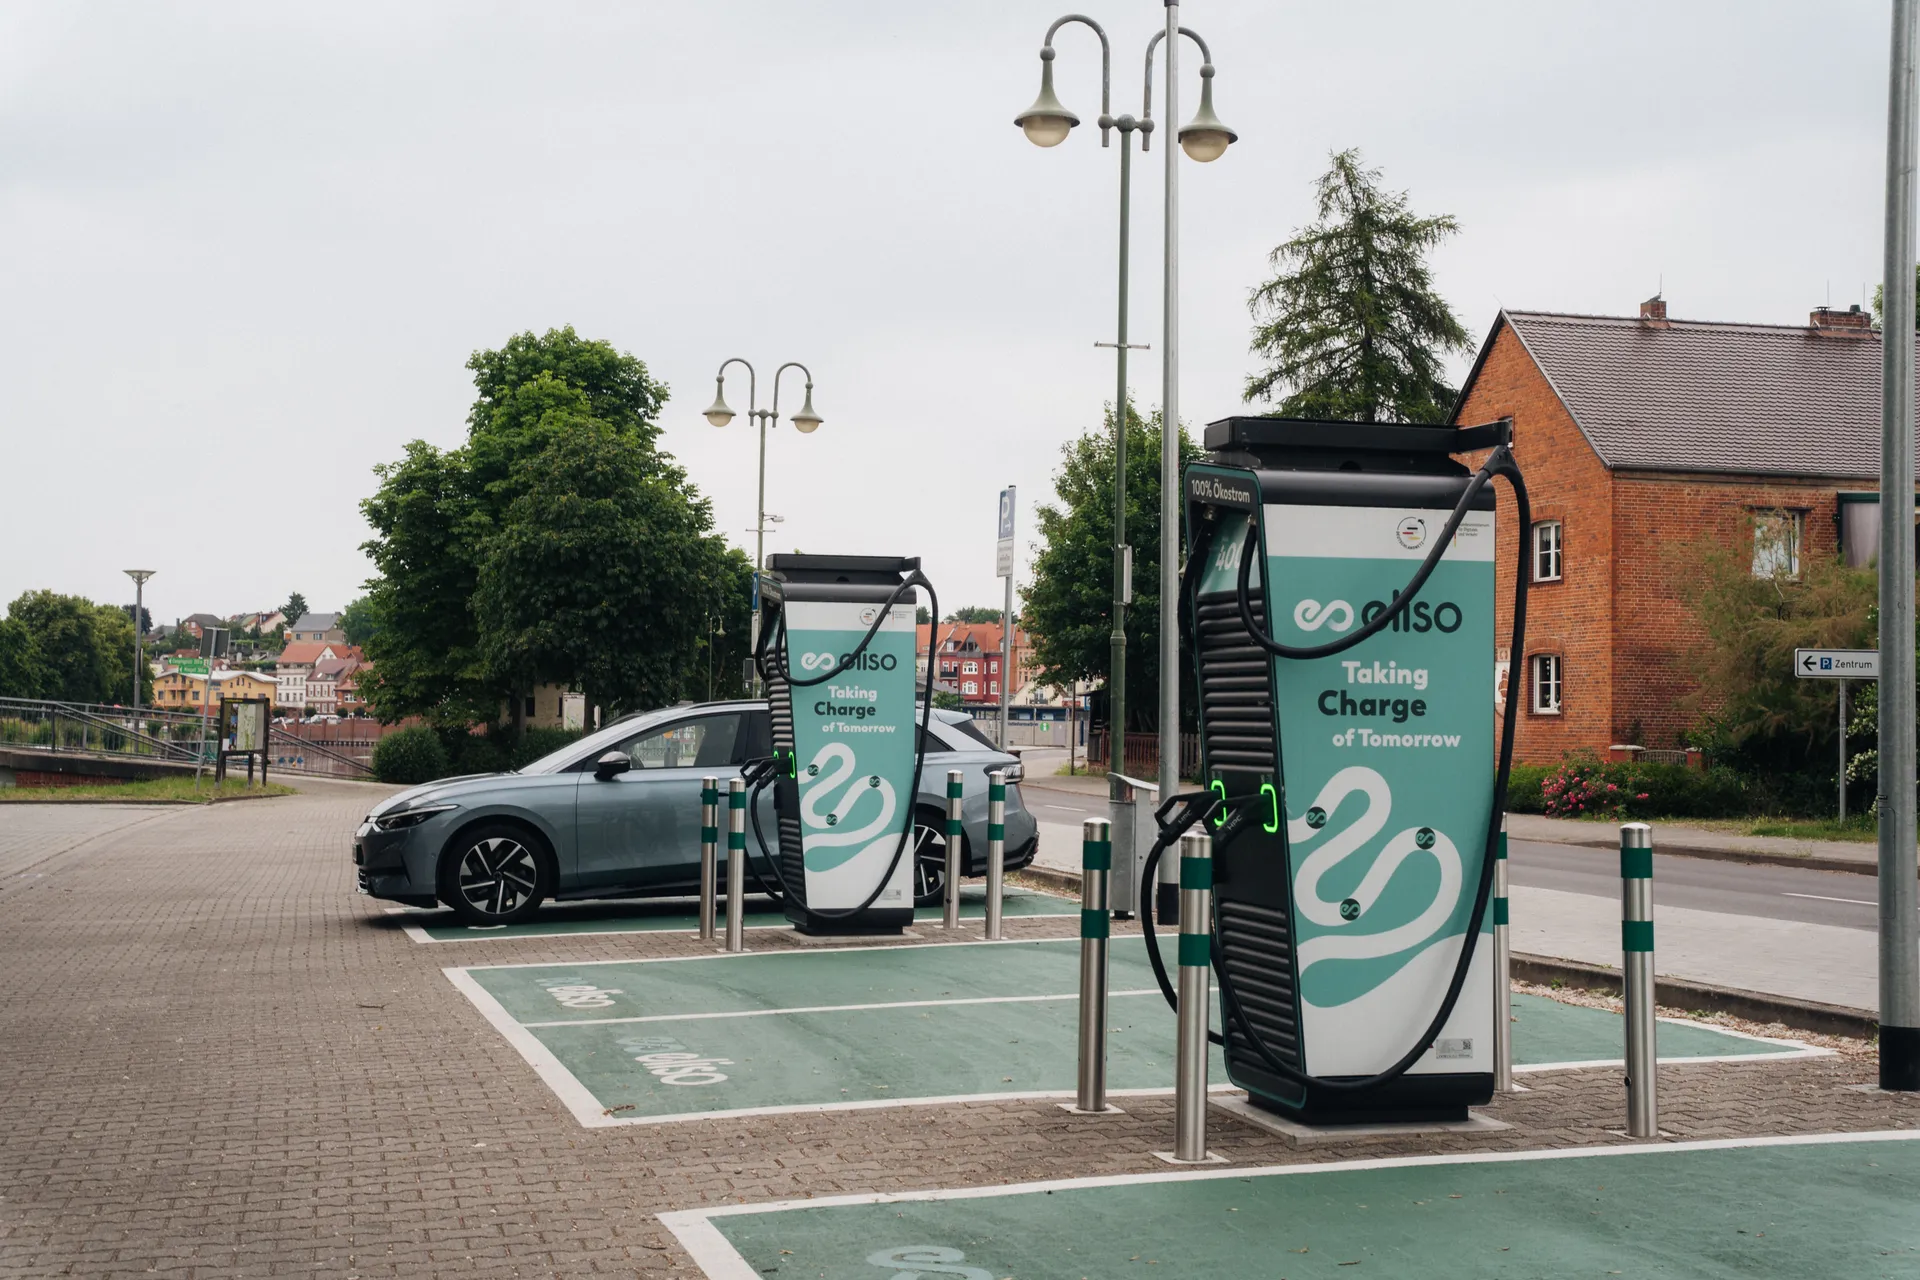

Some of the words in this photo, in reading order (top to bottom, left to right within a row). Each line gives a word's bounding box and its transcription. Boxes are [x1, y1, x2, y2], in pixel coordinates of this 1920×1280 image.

[1191, 479, 1212, 498] 100%
[1213, 478, 1250, 503] Ökostrom
[1361, 589, 1463, 634] eliso
[1835, 659, 1873, 669] Zentrum
[1342, 661, 1429, 690] Taking
[828, 685, 877, 702] Taking
[814, 702, 876, 719] Charge
[1318, 690, 1427, 723] Charge
[822, 722, 835, 733] of
[836, 722, 896, 733] Tomorrow
[1332, 728, 1355, 747] of
[1358, 729, 1461, 748] Tomorrow
[1226, 815, 1243, 830] HPC
